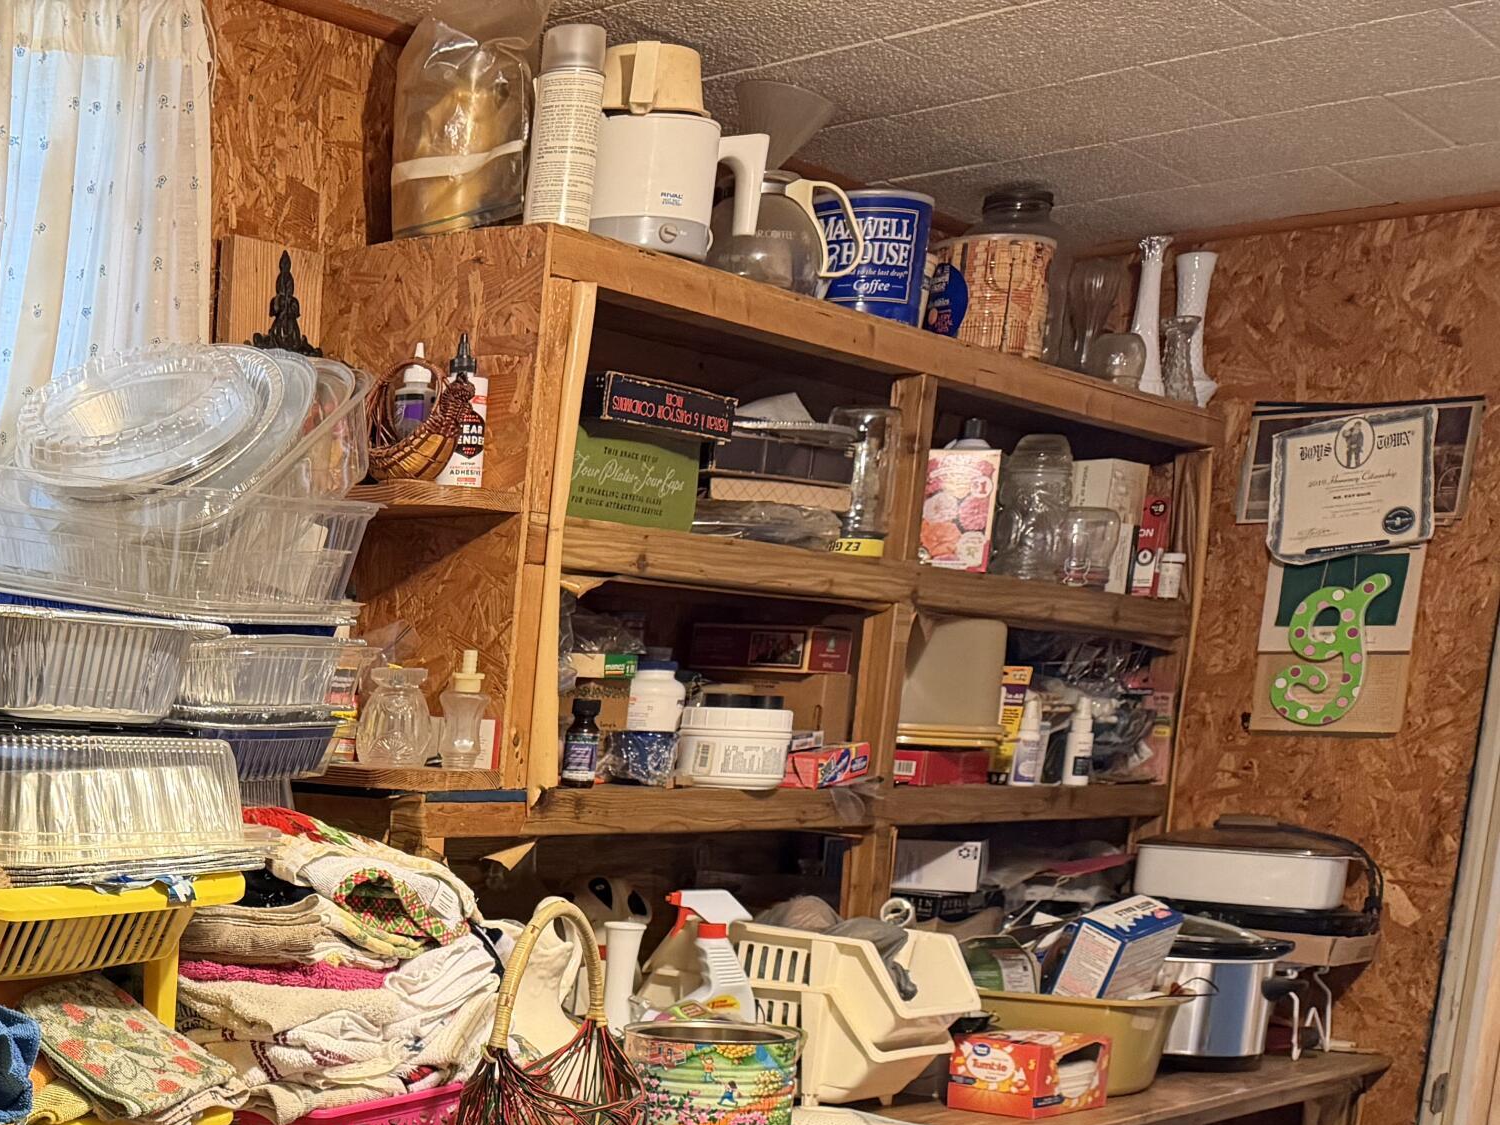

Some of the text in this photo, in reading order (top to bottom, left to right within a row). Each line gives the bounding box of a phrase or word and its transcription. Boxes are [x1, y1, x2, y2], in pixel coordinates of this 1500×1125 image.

[852, 279, 891, 296] Coffee
[460, 424, 483, 434] EAR
[457, 435, 484, 446] ENDE
[1299, 442, 1333, 462] BOYS
